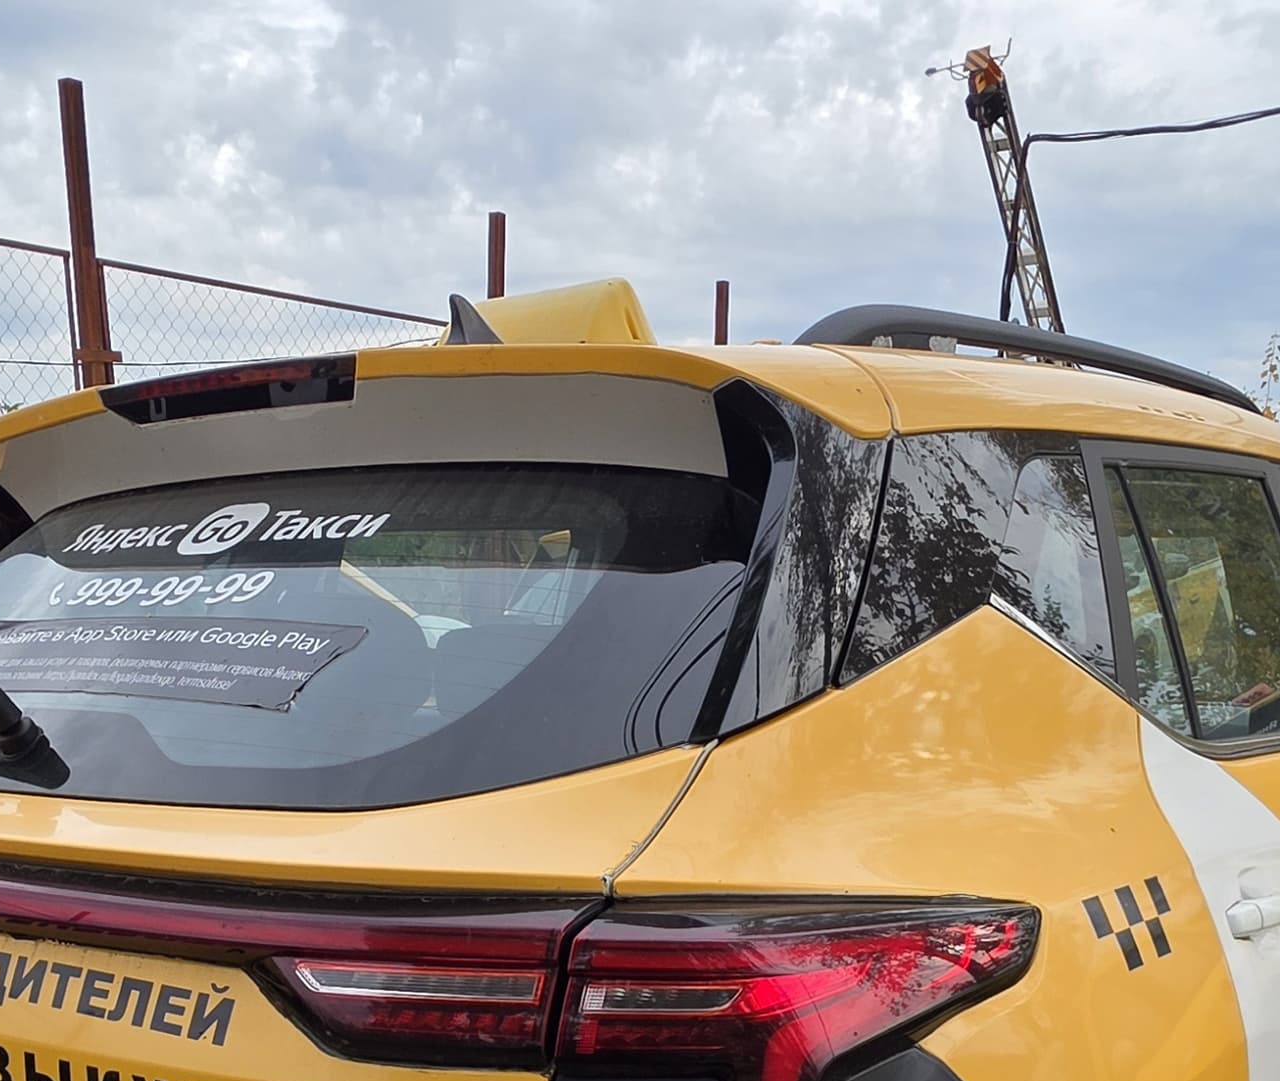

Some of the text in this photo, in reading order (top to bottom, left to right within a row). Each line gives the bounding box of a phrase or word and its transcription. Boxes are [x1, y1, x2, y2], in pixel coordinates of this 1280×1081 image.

[62, 523, 189, 553] Яндекс
[259, 510, 392, 542] Такси
[67, 571, 275, 607] 999-99-99
[64, 626, 105, 643] App
[104, 625, 157, 642] Store
[156, 628, 200, 642] или
[200, 627, 277, 650] Google
[277, 632, 331, 656] Play
